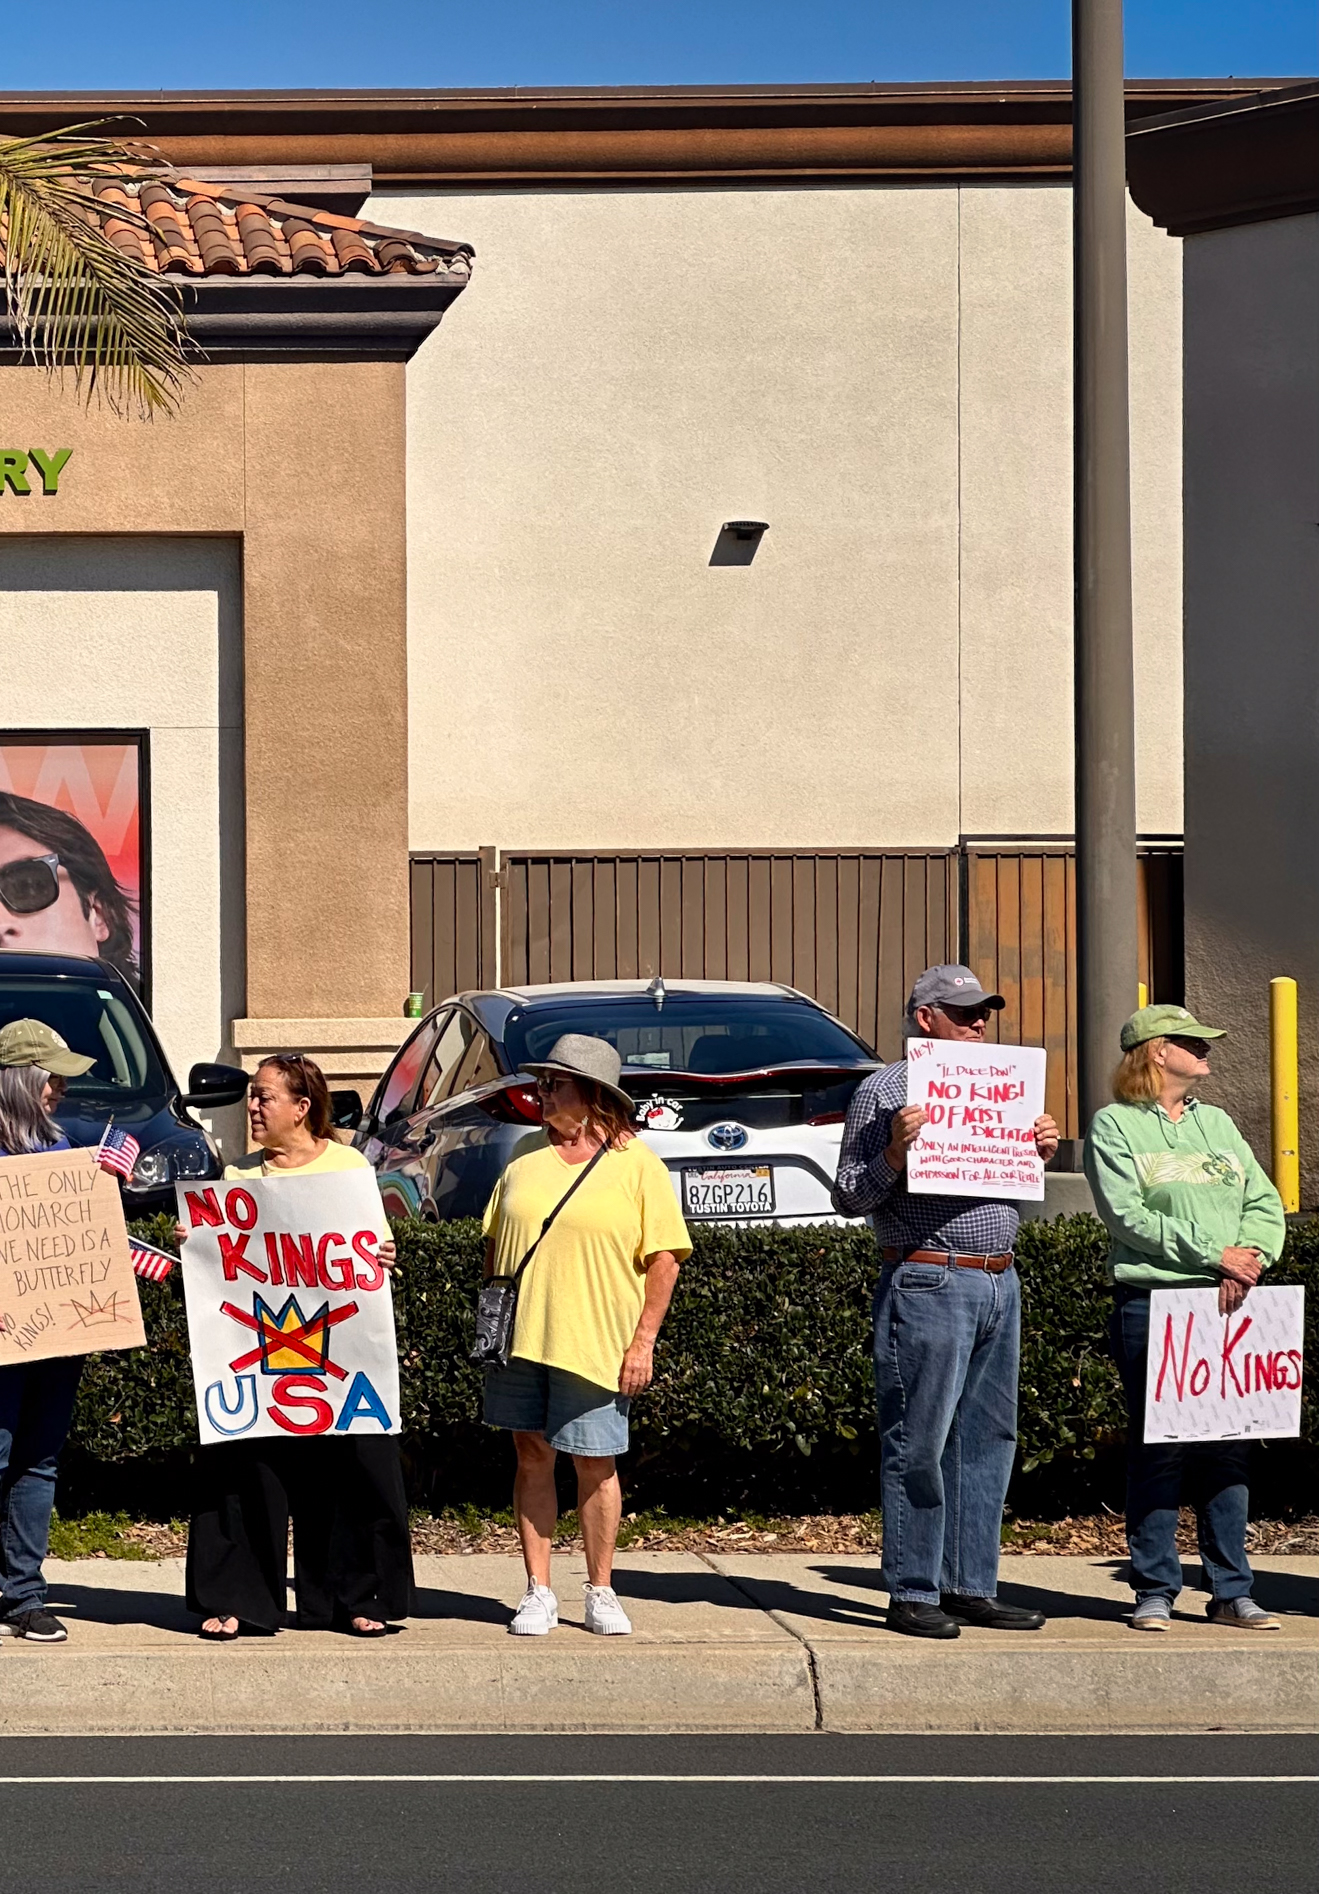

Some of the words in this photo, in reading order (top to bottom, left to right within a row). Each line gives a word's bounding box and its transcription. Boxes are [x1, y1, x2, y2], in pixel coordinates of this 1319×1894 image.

[927, 1080, 962, 1099] NO
[947, 1142, 959, 1152] AN
[47, 1168, 98, 1196] ONLY
[700, 1170, 758, 1184] California
[983, 1168, 1000, 1180] ALL
[689, 1182, 768, 1205] 8ZGP216
[689, 1202, 728, 1214] TUSTIN
[730, 1201, 772, 1213] TOYOTA
[184, 1187, 258, 1231] NO
[26, 1233, 76, 1262] NEED
[81, 1228, 97, 1252] IS
[99, 1227, 112, 1251] A
[217, 1230, 386, 1292] KINGS
[13, 1257, 112, 1297] BUTTERFLY
[13, 1301, 57, 1352] KINGS!
[204, 1371, 393, 1436] USA
